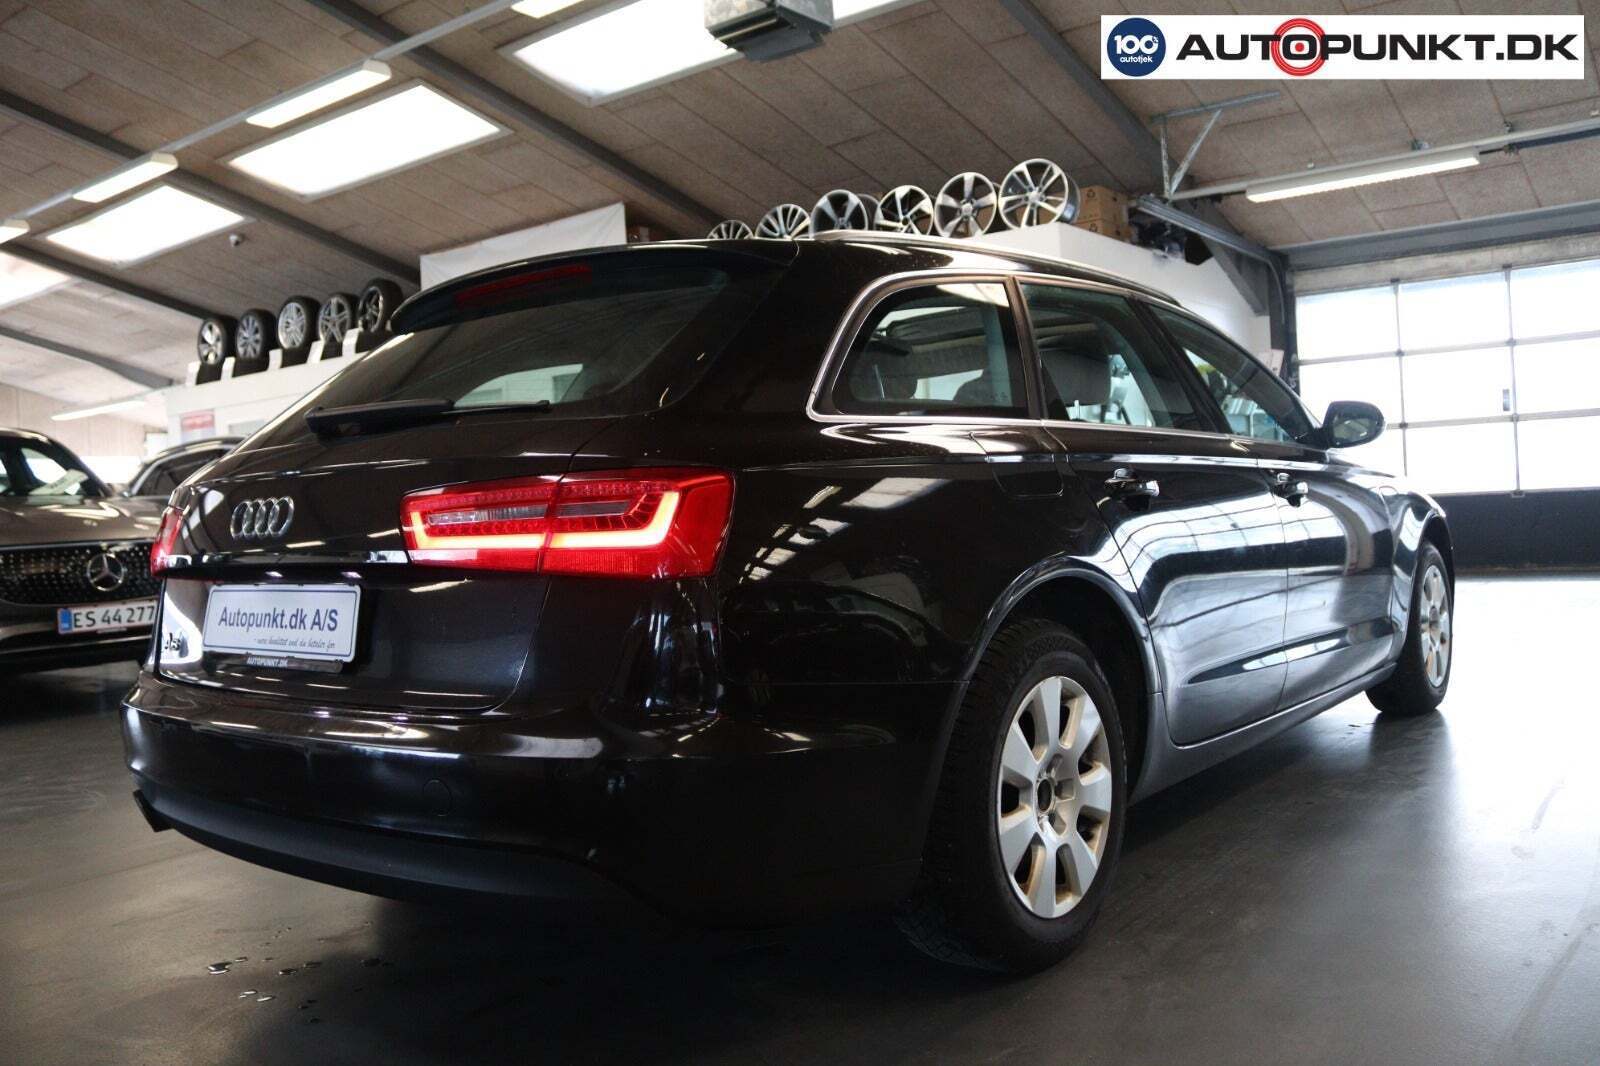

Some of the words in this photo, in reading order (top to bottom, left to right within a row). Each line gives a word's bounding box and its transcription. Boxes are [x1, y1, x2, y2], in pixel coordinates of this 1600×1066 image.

[73, 611, 96, 628] ES
[218, 606, 307, 632] Autopunkt.dk
[310, 608, 339, 632] A/S
